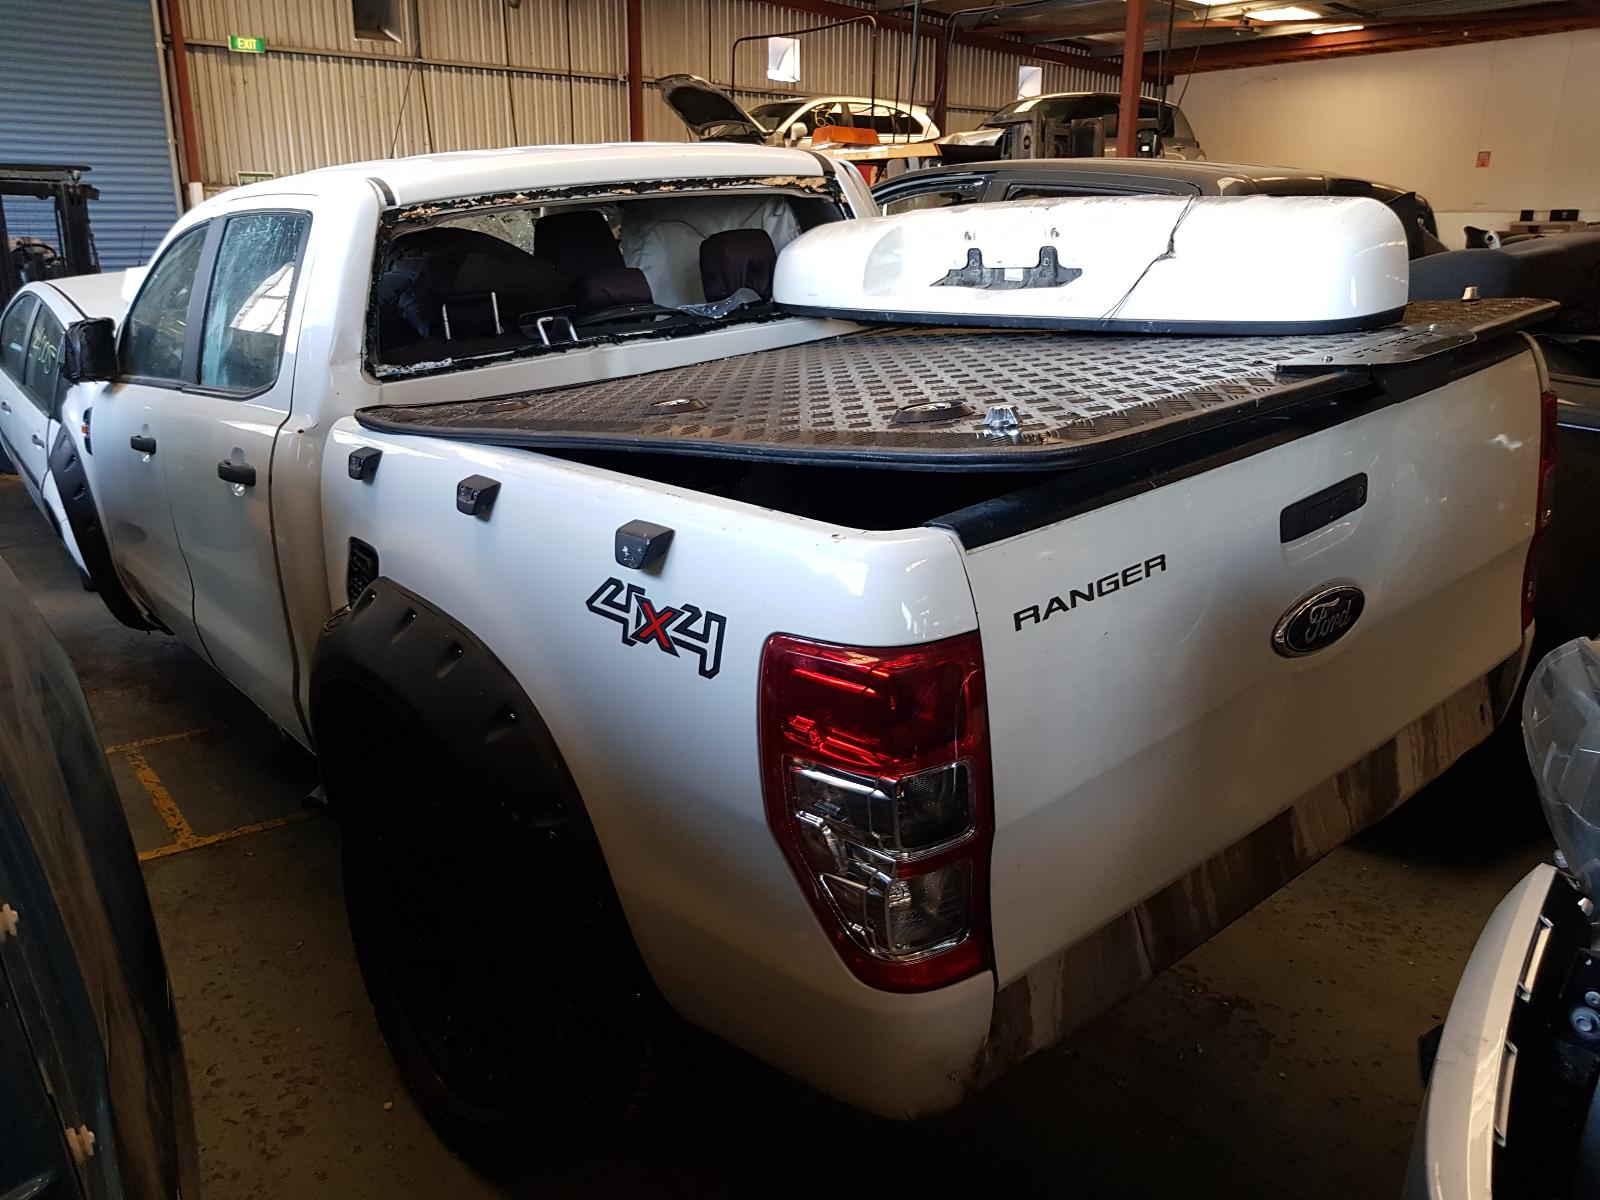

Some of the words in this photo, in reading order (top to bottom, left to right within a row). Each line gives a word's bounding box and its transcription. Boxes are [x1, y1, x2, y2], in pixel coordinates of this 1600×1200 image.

[237, 38, 257, 50] EXIT
[1013, 553, 1167, 632] RANGER
[1304, 596, 1353, 644] Ford
